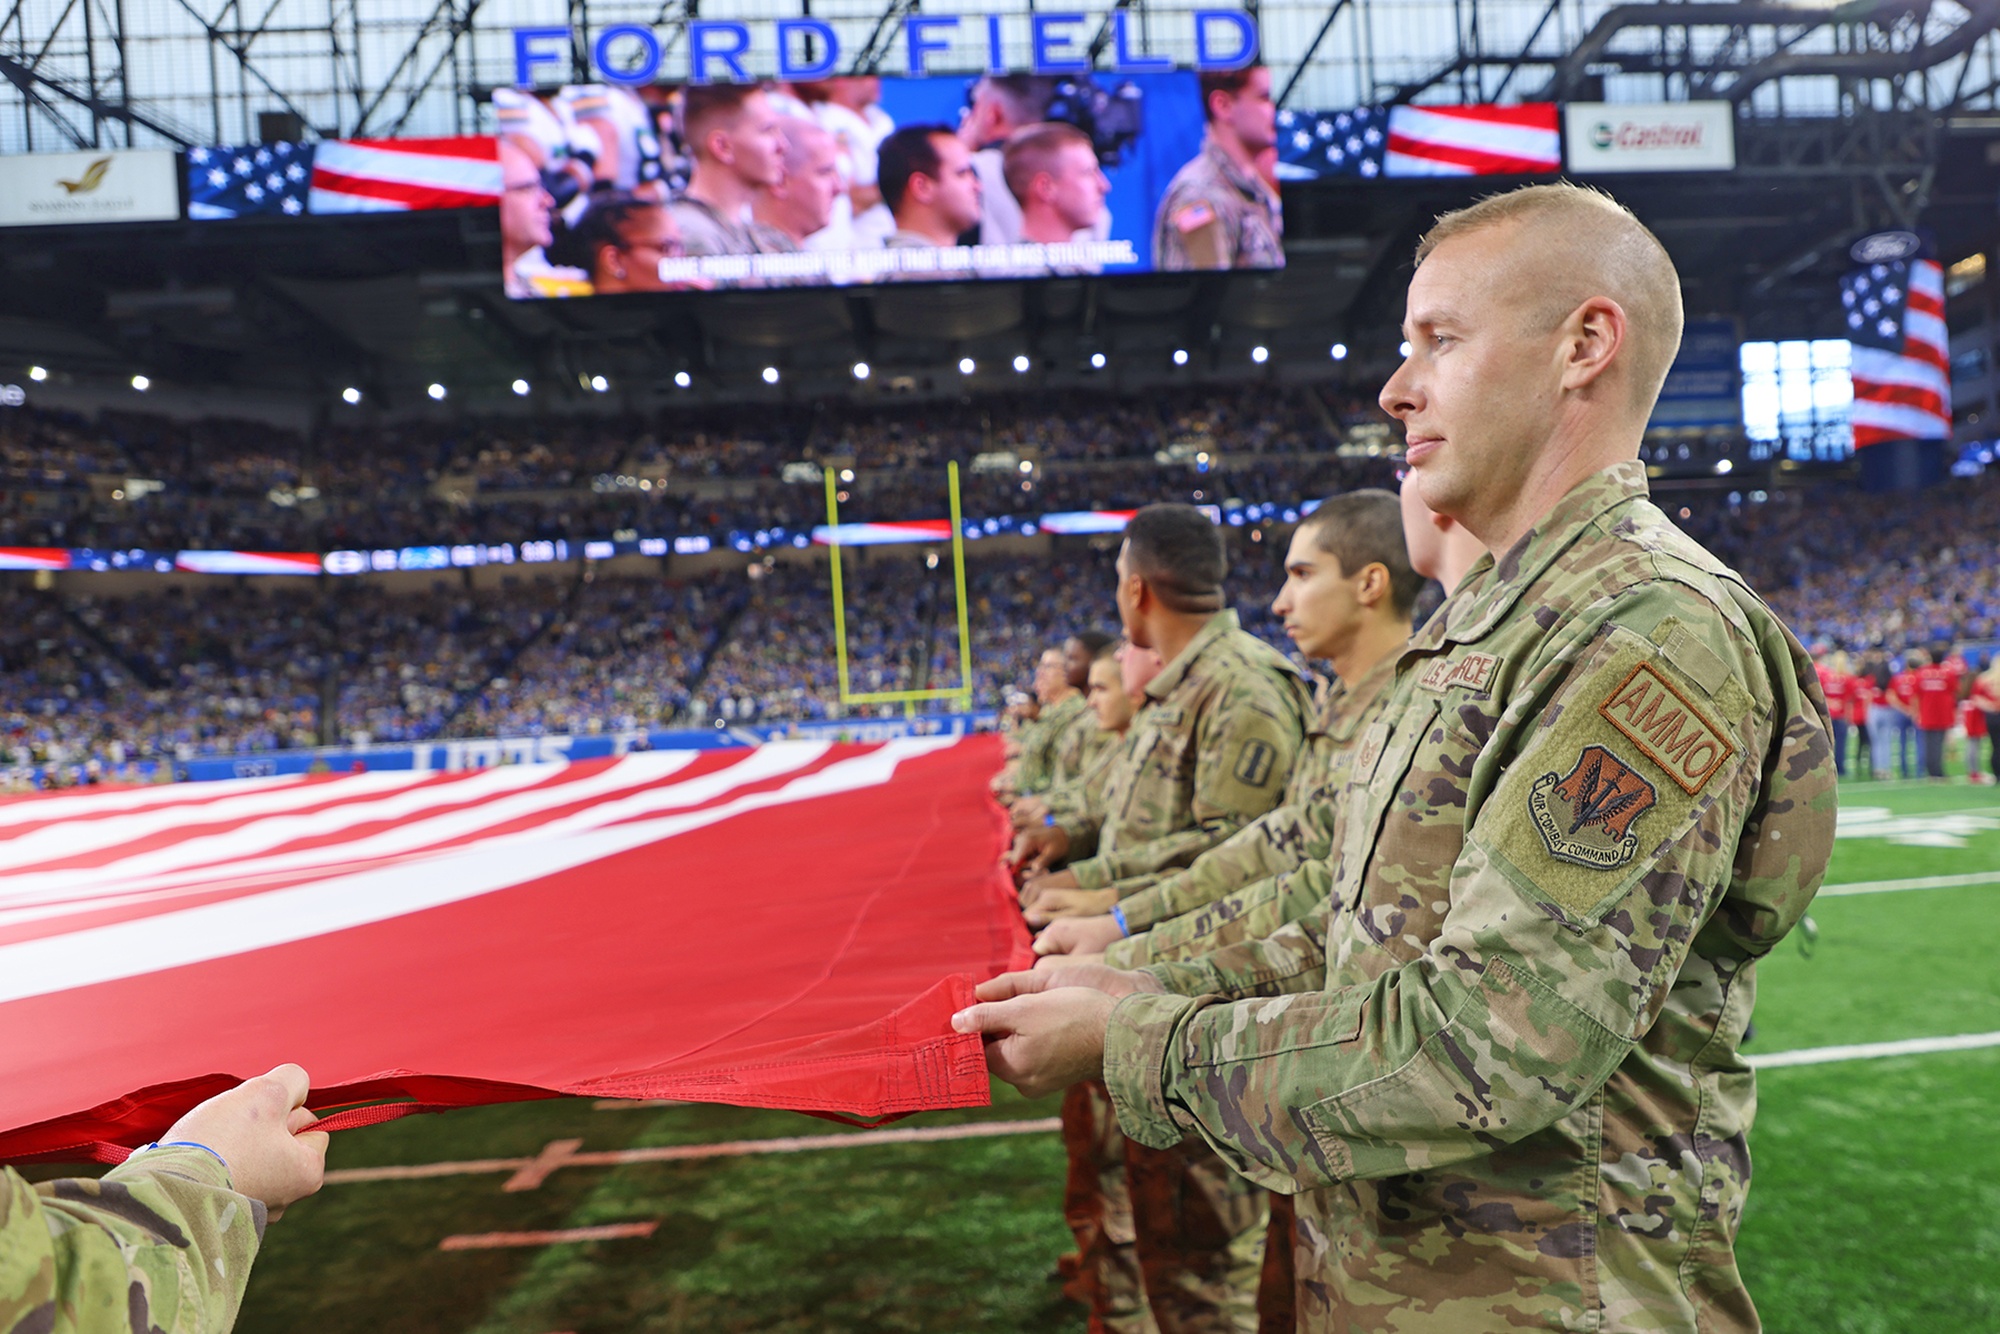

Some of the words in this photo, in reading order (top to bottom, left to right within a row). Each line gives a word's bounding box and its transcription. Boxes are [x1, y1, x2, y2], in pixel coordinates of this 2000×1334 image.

[513, 17, 841, 90] FORD
[902, 8, 1261, 77] FIELD
[1609, 679, 1718, 778] AMMO
[1533, 792, 1546, 811] AIR
[1539, 812, 1567, 851] COMBAT
[1567, 843, 1619, 862] COMMAND
